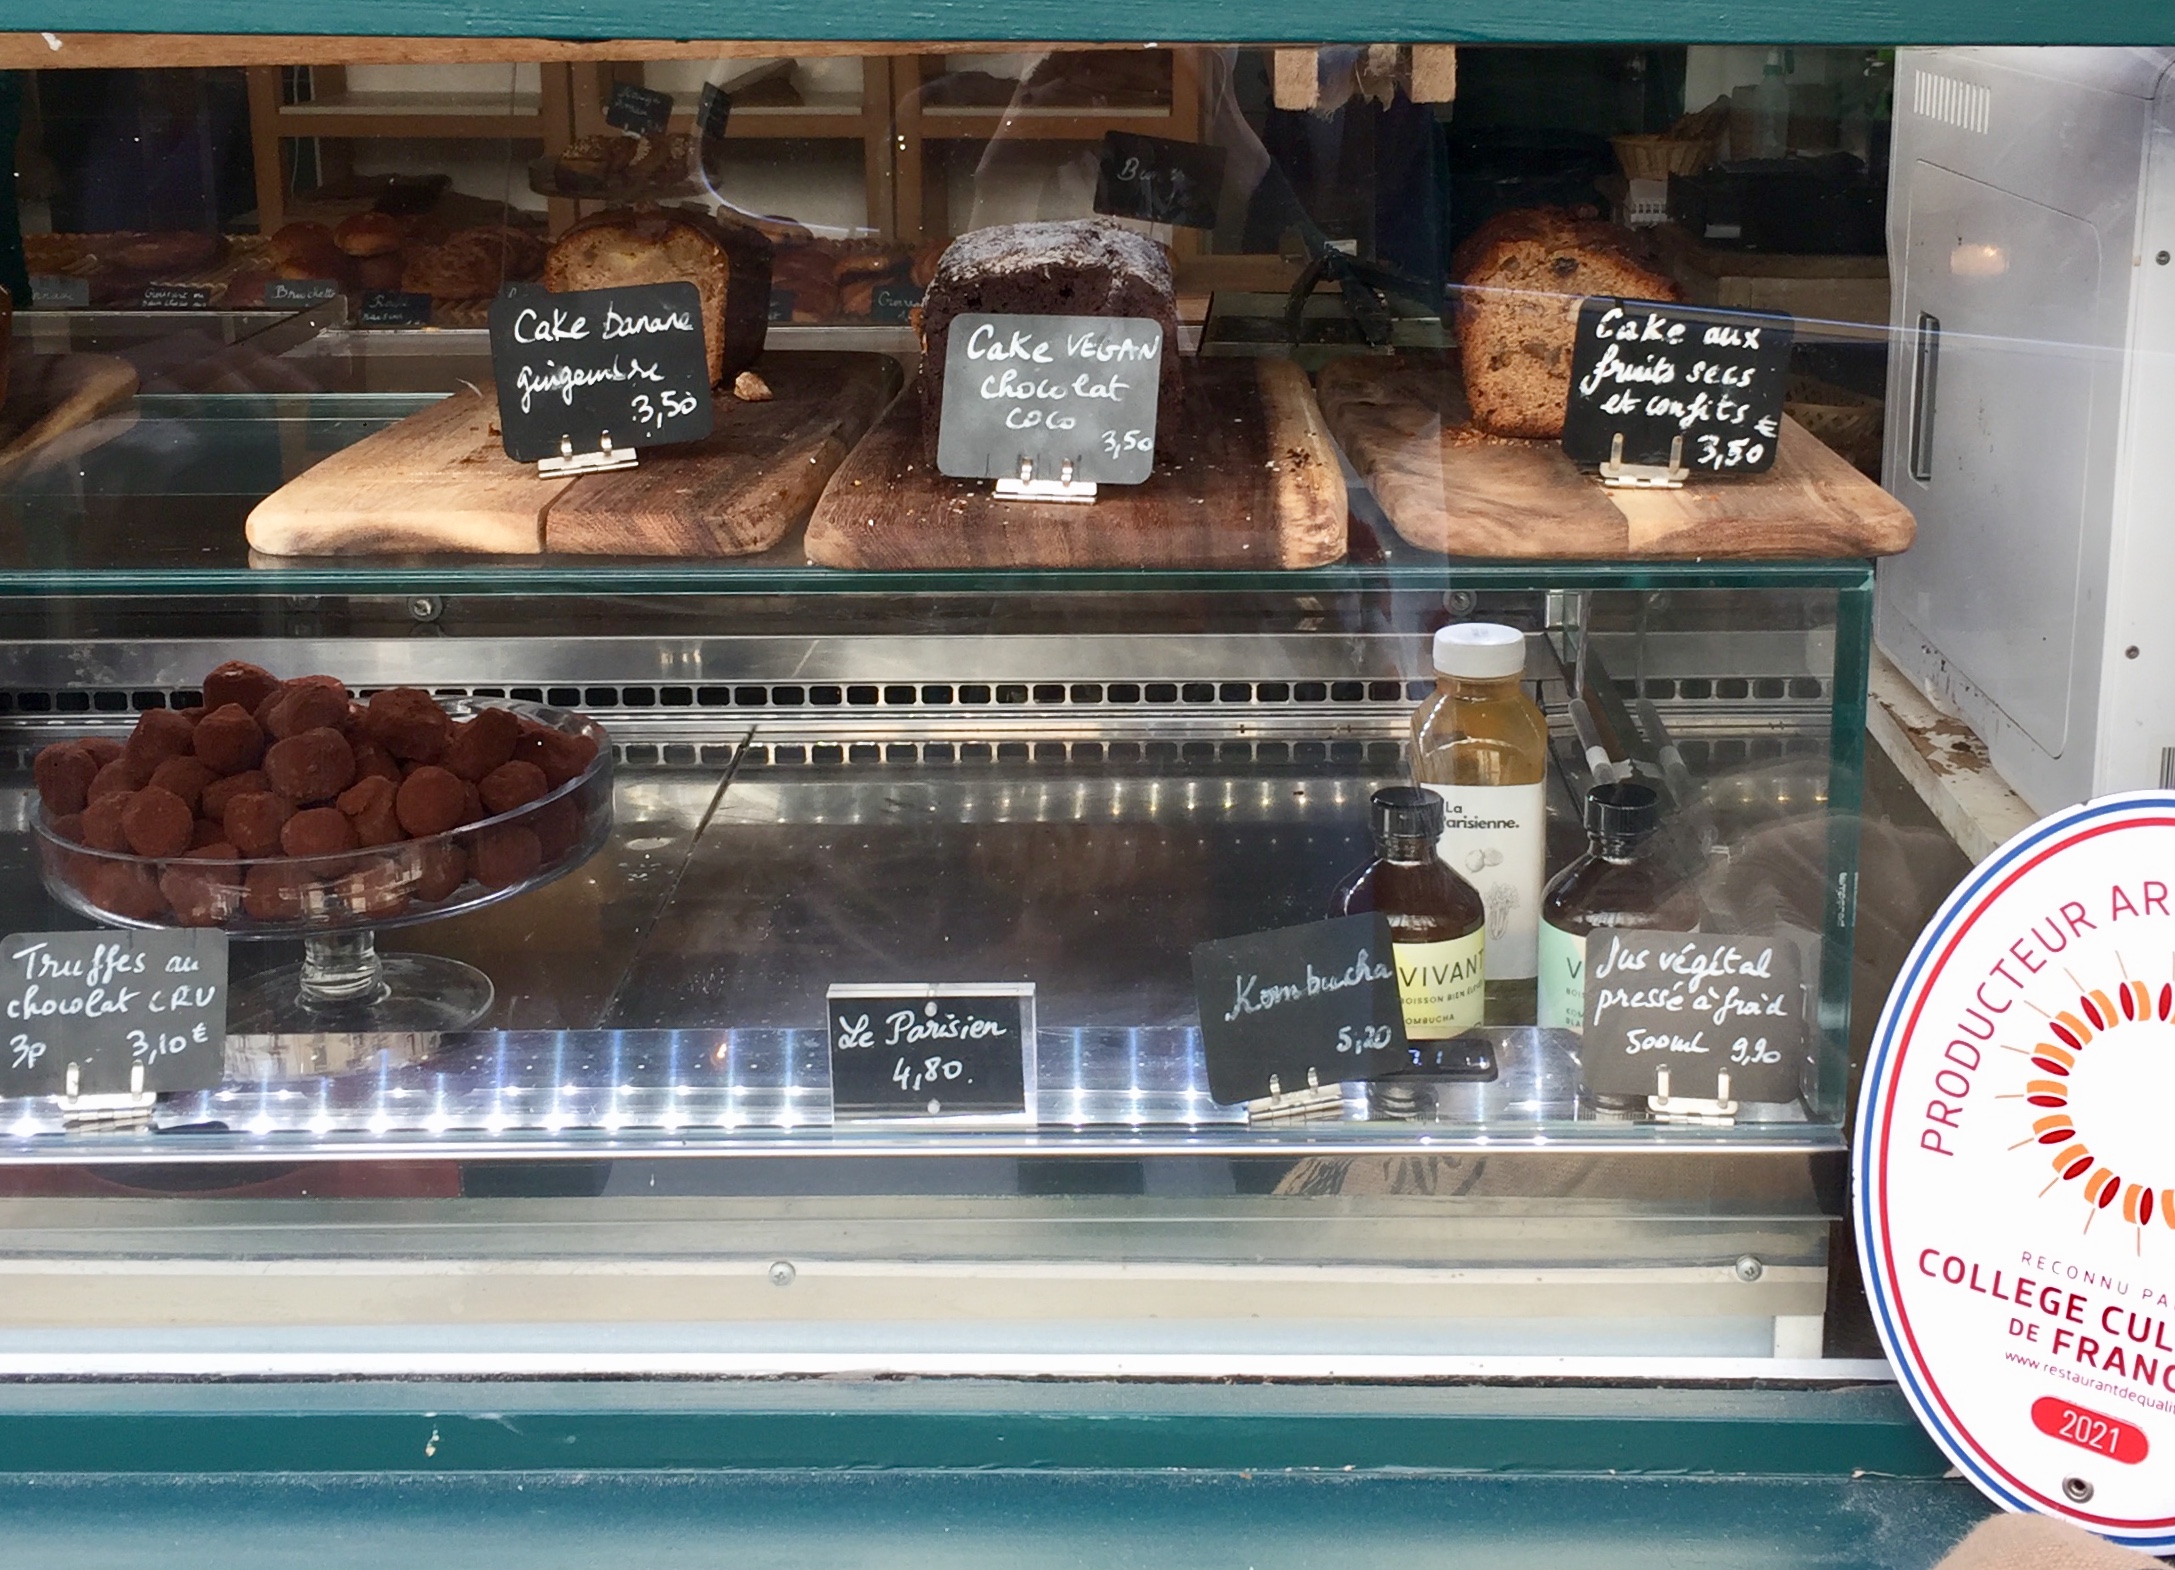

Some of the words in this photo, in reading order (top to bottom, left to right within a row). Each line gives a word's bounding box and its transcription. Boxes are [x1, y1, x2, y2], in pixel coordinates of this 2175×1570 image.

[514, 308, 590, 343] Cake
[602, 301, 694, 340] banane
[1596, 307, 1686, 345] Cake
[1703, 326, 1762, 350] aux
[967, 324, 1053, 363] Cake
[1067, 332, 1160, 362] VEGAN
[516, 354, 665, 414] gingembre
[1579, 343, 1675, 397] fruits
[1685, 360, 1756, 388] secs
[631, 390, 698, 429] 3,50
[1600, 388, 1641, 415] et
[1645, 391, 1751, 430] confits
[1101, 429, 1154, 459] 3,50
[1443, 815, 1520, 829] arisienne.
[1445, 801, 1462, 813] La
[12, 942, 147, 987] Truffes
[165, 955, 200, 973] au
[1224, 948, 1394, 1022] Kombucha
[1595, 936, 1650, 978] Jus
[1659, 942, 1773, 994] végétal
[7, 984, 141, 1020] chocolat
[148, 984, 216, 1013] CRU
[1405, 1013, 1455, 1025] OMBUCHA
[1593, 981, 1685, 1027] pressé
[1692, 986, 1720, 1010] à
[838, 1013, 875, 1049] Le
[885, 1010, 1007, 1045] Parisien
[1335, 1024, 1393, 1055] 5,20
[1920, 901, 2098, 1157] PRODUCTEUR
[1730, 1037, 1782, 1066] 9,90
[1918, 1248, 2088, 1324] COLLEGE
[2101, 1305, 2173, 1352] CUL
[2021, 1250, 2129, 1295] RECONNU
[2141, 1288, 2175, 1311] PA
[2008, 1317, 2040, 1342] DE
[2059, 1409, 2121, 1454] 2021
